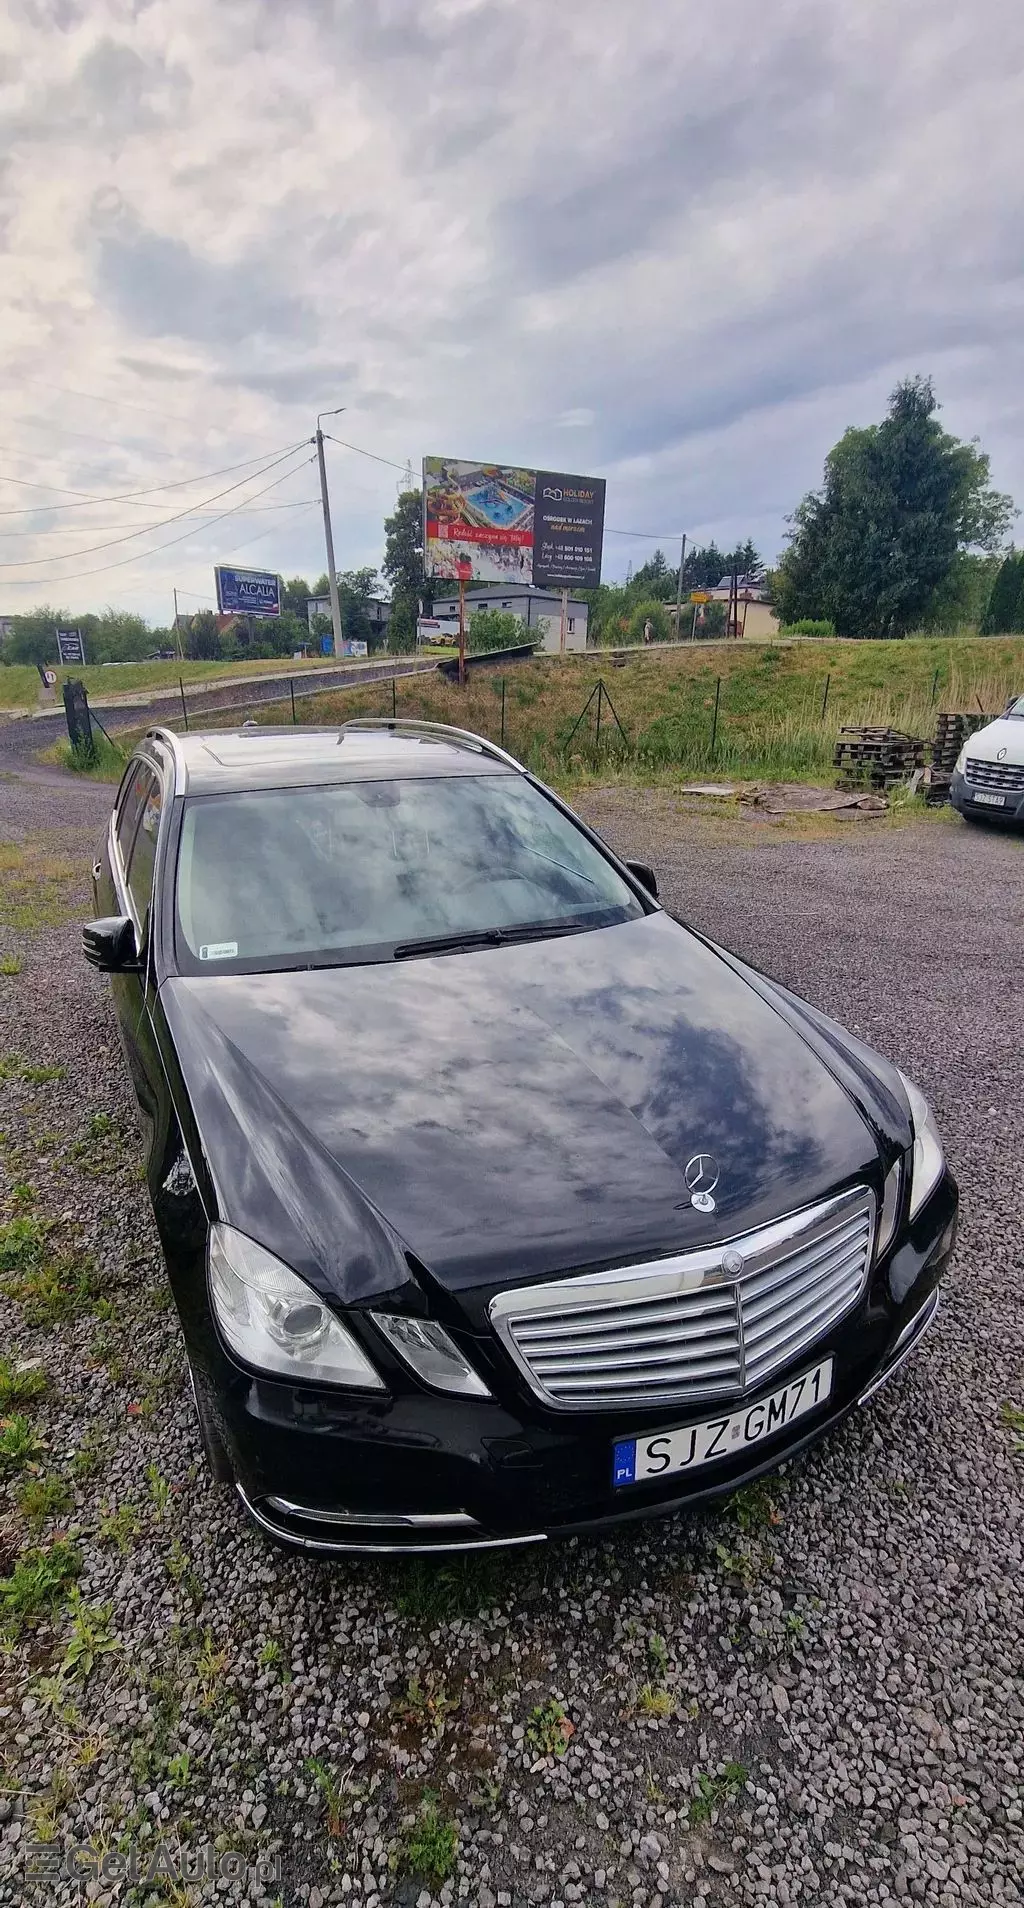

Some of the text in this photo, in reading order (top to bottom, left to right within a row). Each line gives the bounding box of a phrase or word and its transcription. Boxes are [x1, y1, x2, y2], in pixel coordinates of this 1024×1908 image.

[563, 488, 594, 499] HOLIDAY
[239, 584, 276, 598] ALCALIA
[646, 1368, 821, 1474] SJZ GM71
[617, 1467, 633, 1479] PL
